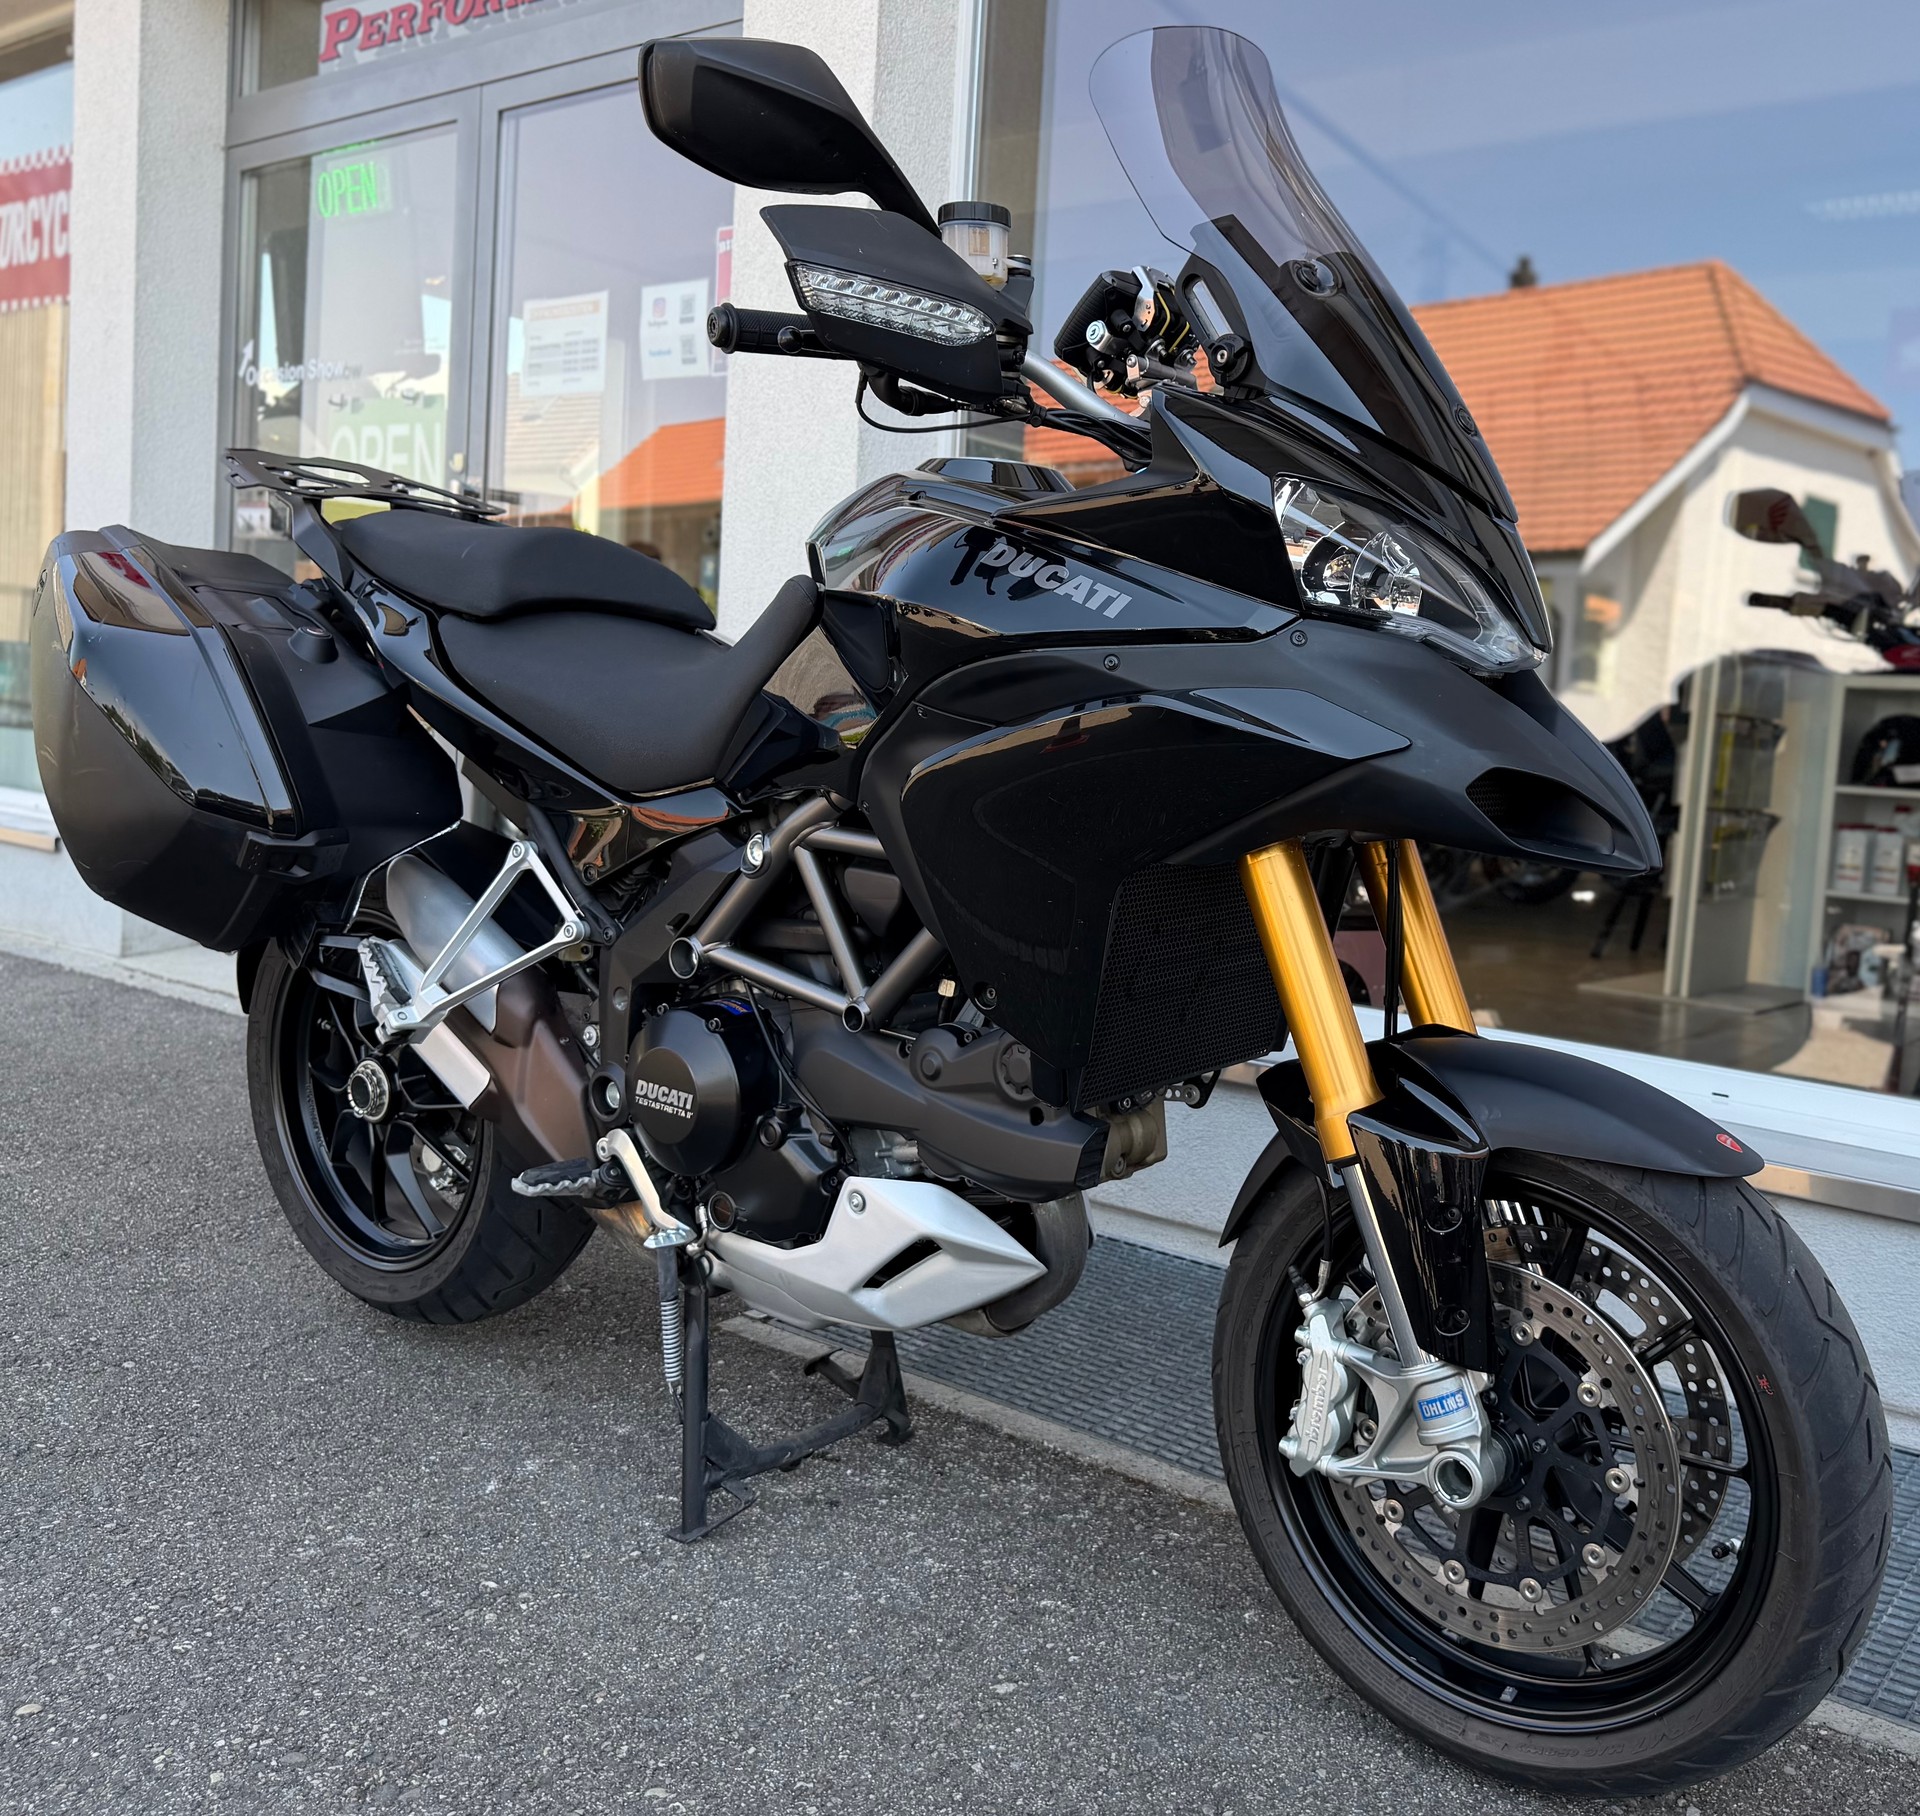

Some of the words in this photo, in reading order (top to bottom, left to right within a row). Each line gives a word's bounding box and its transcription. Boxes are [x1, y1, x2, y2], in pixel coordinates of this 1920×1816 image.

[318, 0, 541, 63] PERFO
[317, 161, 378, 218] OPEN
[0, 189, 69, 269] ORCYC
[980, 542, 1133, 619] DUCATI
[635, 1079, 694, 1110] DUCATI
[635, 1095, 686, 1118] TESTASTRETTA
[1422, 1393, 1465, 1417] ÖHLINS
